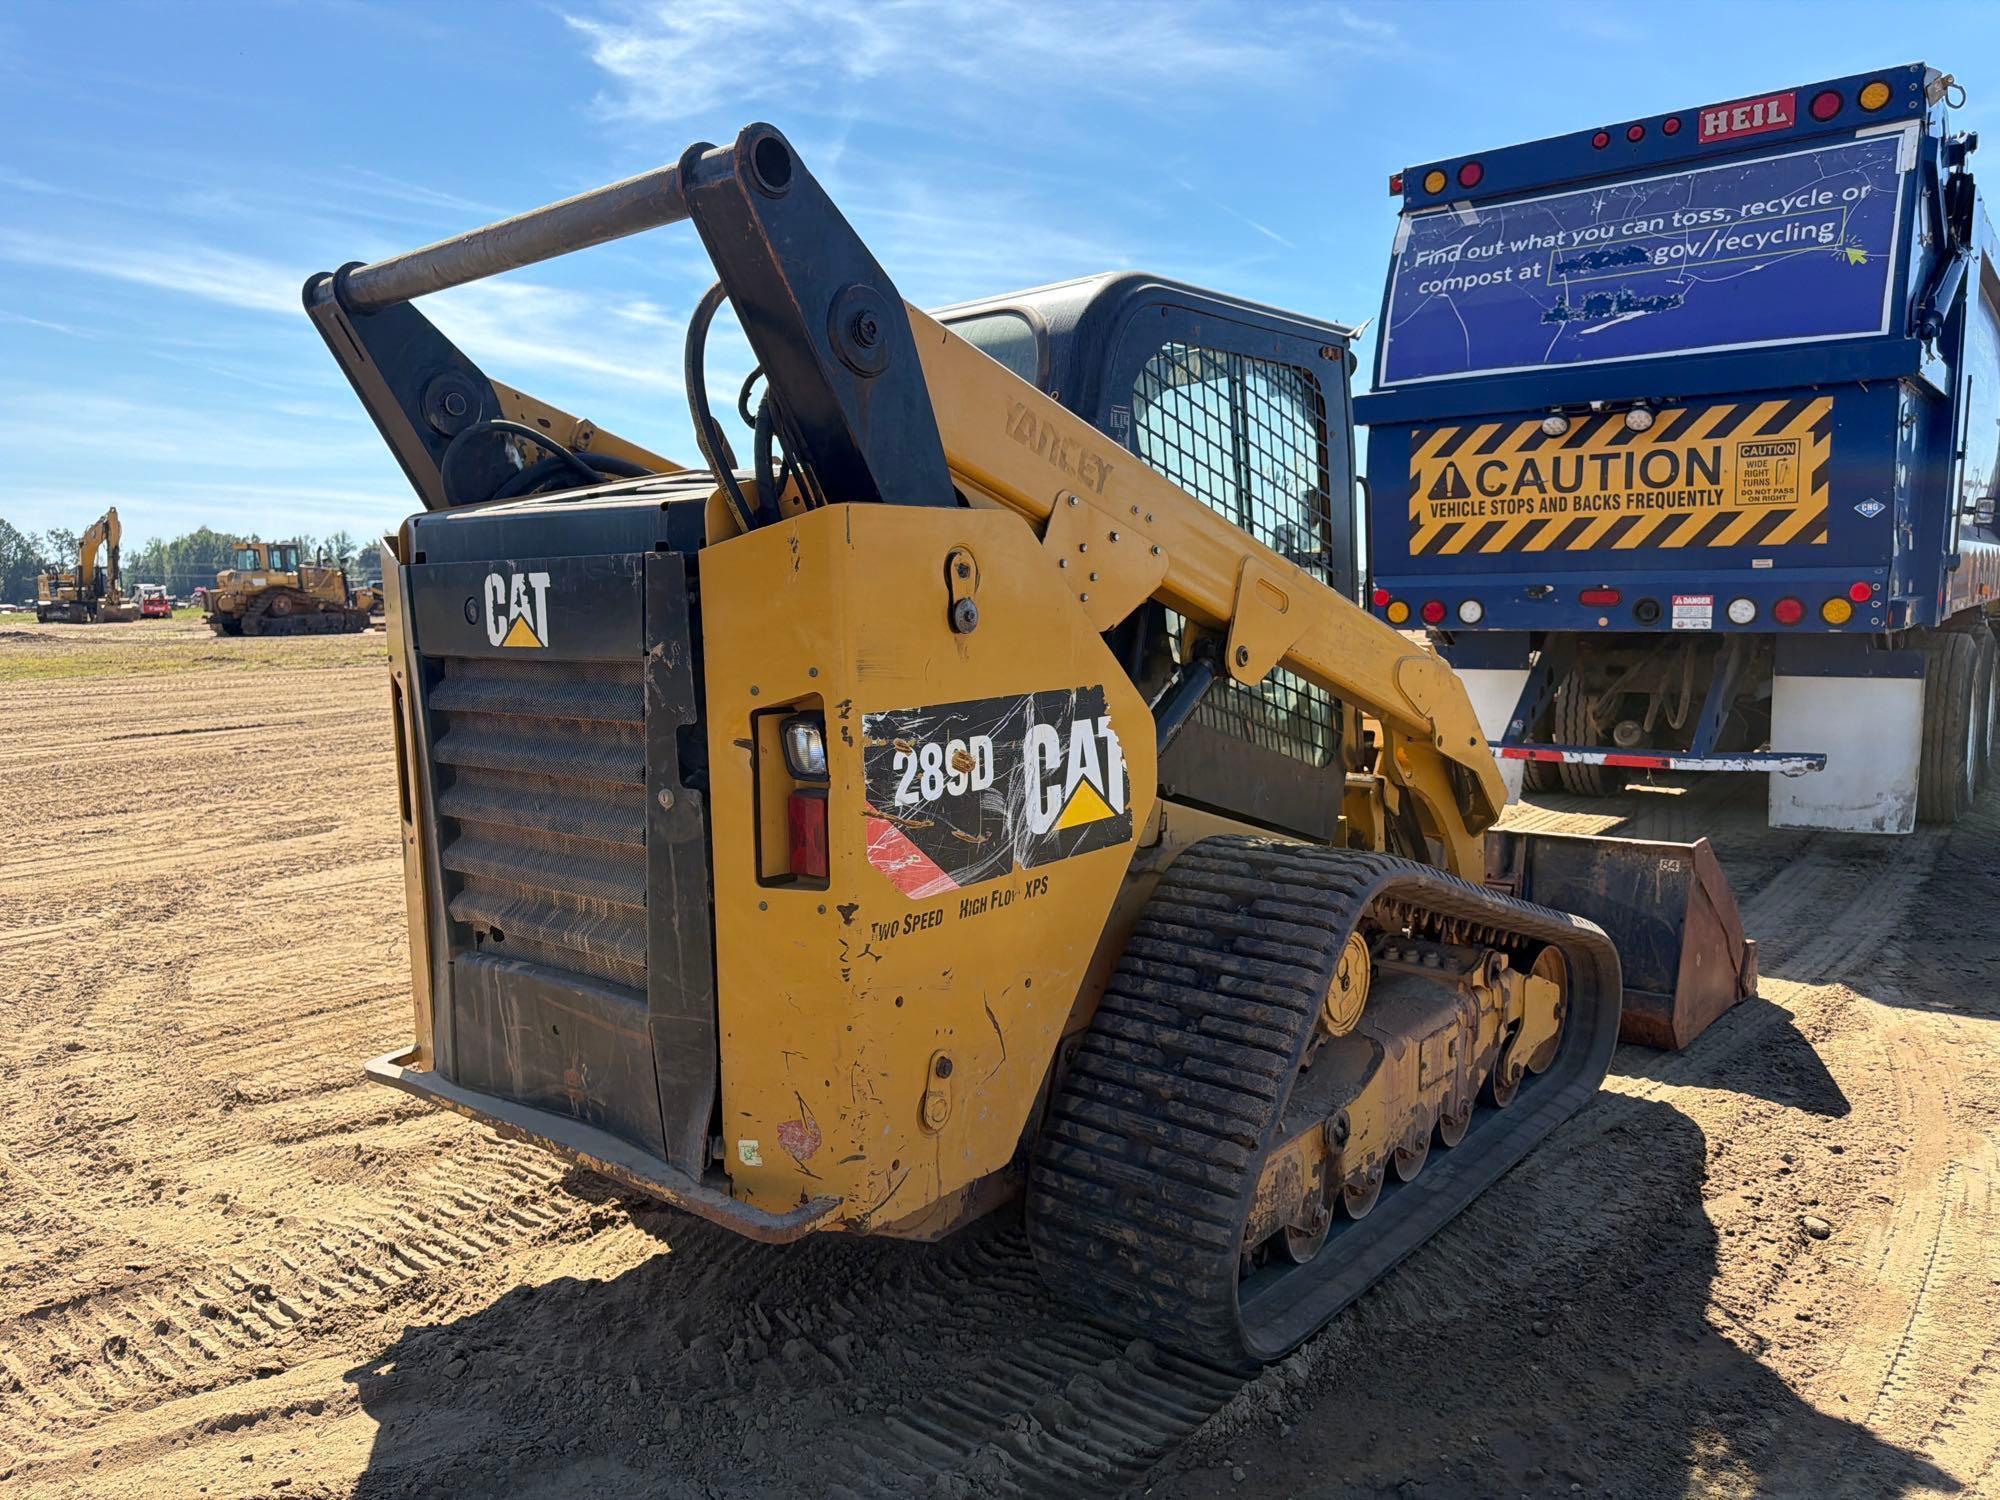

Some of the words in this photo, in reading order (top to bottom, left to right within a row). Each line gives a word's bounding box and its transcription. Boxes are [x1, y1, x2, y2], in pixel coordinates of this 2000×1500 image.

[1704, 101, 1788, 136] HEIL
[1415, 244, 1460, 267] Find
[1467, 240, 1504, 260] out
[1510, 231, 1567, 253] what
[1572, 224, 1614, 246] you
[1621, 218, 1664, 236] can
[1672, 207, 1732, 228] toss,
[1741, 188, 1833, 217] recycle
[1842, 184, 1873, 201] or
[1419, 266, 1512, 293] compost
[1518, 263, 1542, 280] at
[1741, 444, 1795, 457] CAUTION
[1746, 459, 1768, 468] WIDE
[1476, 446, 1722, 497] CAUTION
[1743, 478, 1770, 487] TURNS
[1744, 469, 1769, 478] RIGHT
[1430, 500, 1486, 518] VEHICLE
[1490, 498, 1534, 516] STOPS
[1539, 496, 1567, 513] AND
[1573, 493, 1621, 512] BACKS
[1626, 489, 1724, 510] FREQUENTLY
[1762, 494, 1787, 502] RIGHT
[484, 572, 551, 647] CAT
[1023, 716, 1125, 834] CAT
[959, 896, 987, 920] HIGH
[1024, 875, 1049, 900] XPS
[871, 920, 899, 942] TWO
[903, 909, 944, 935] SPEED
